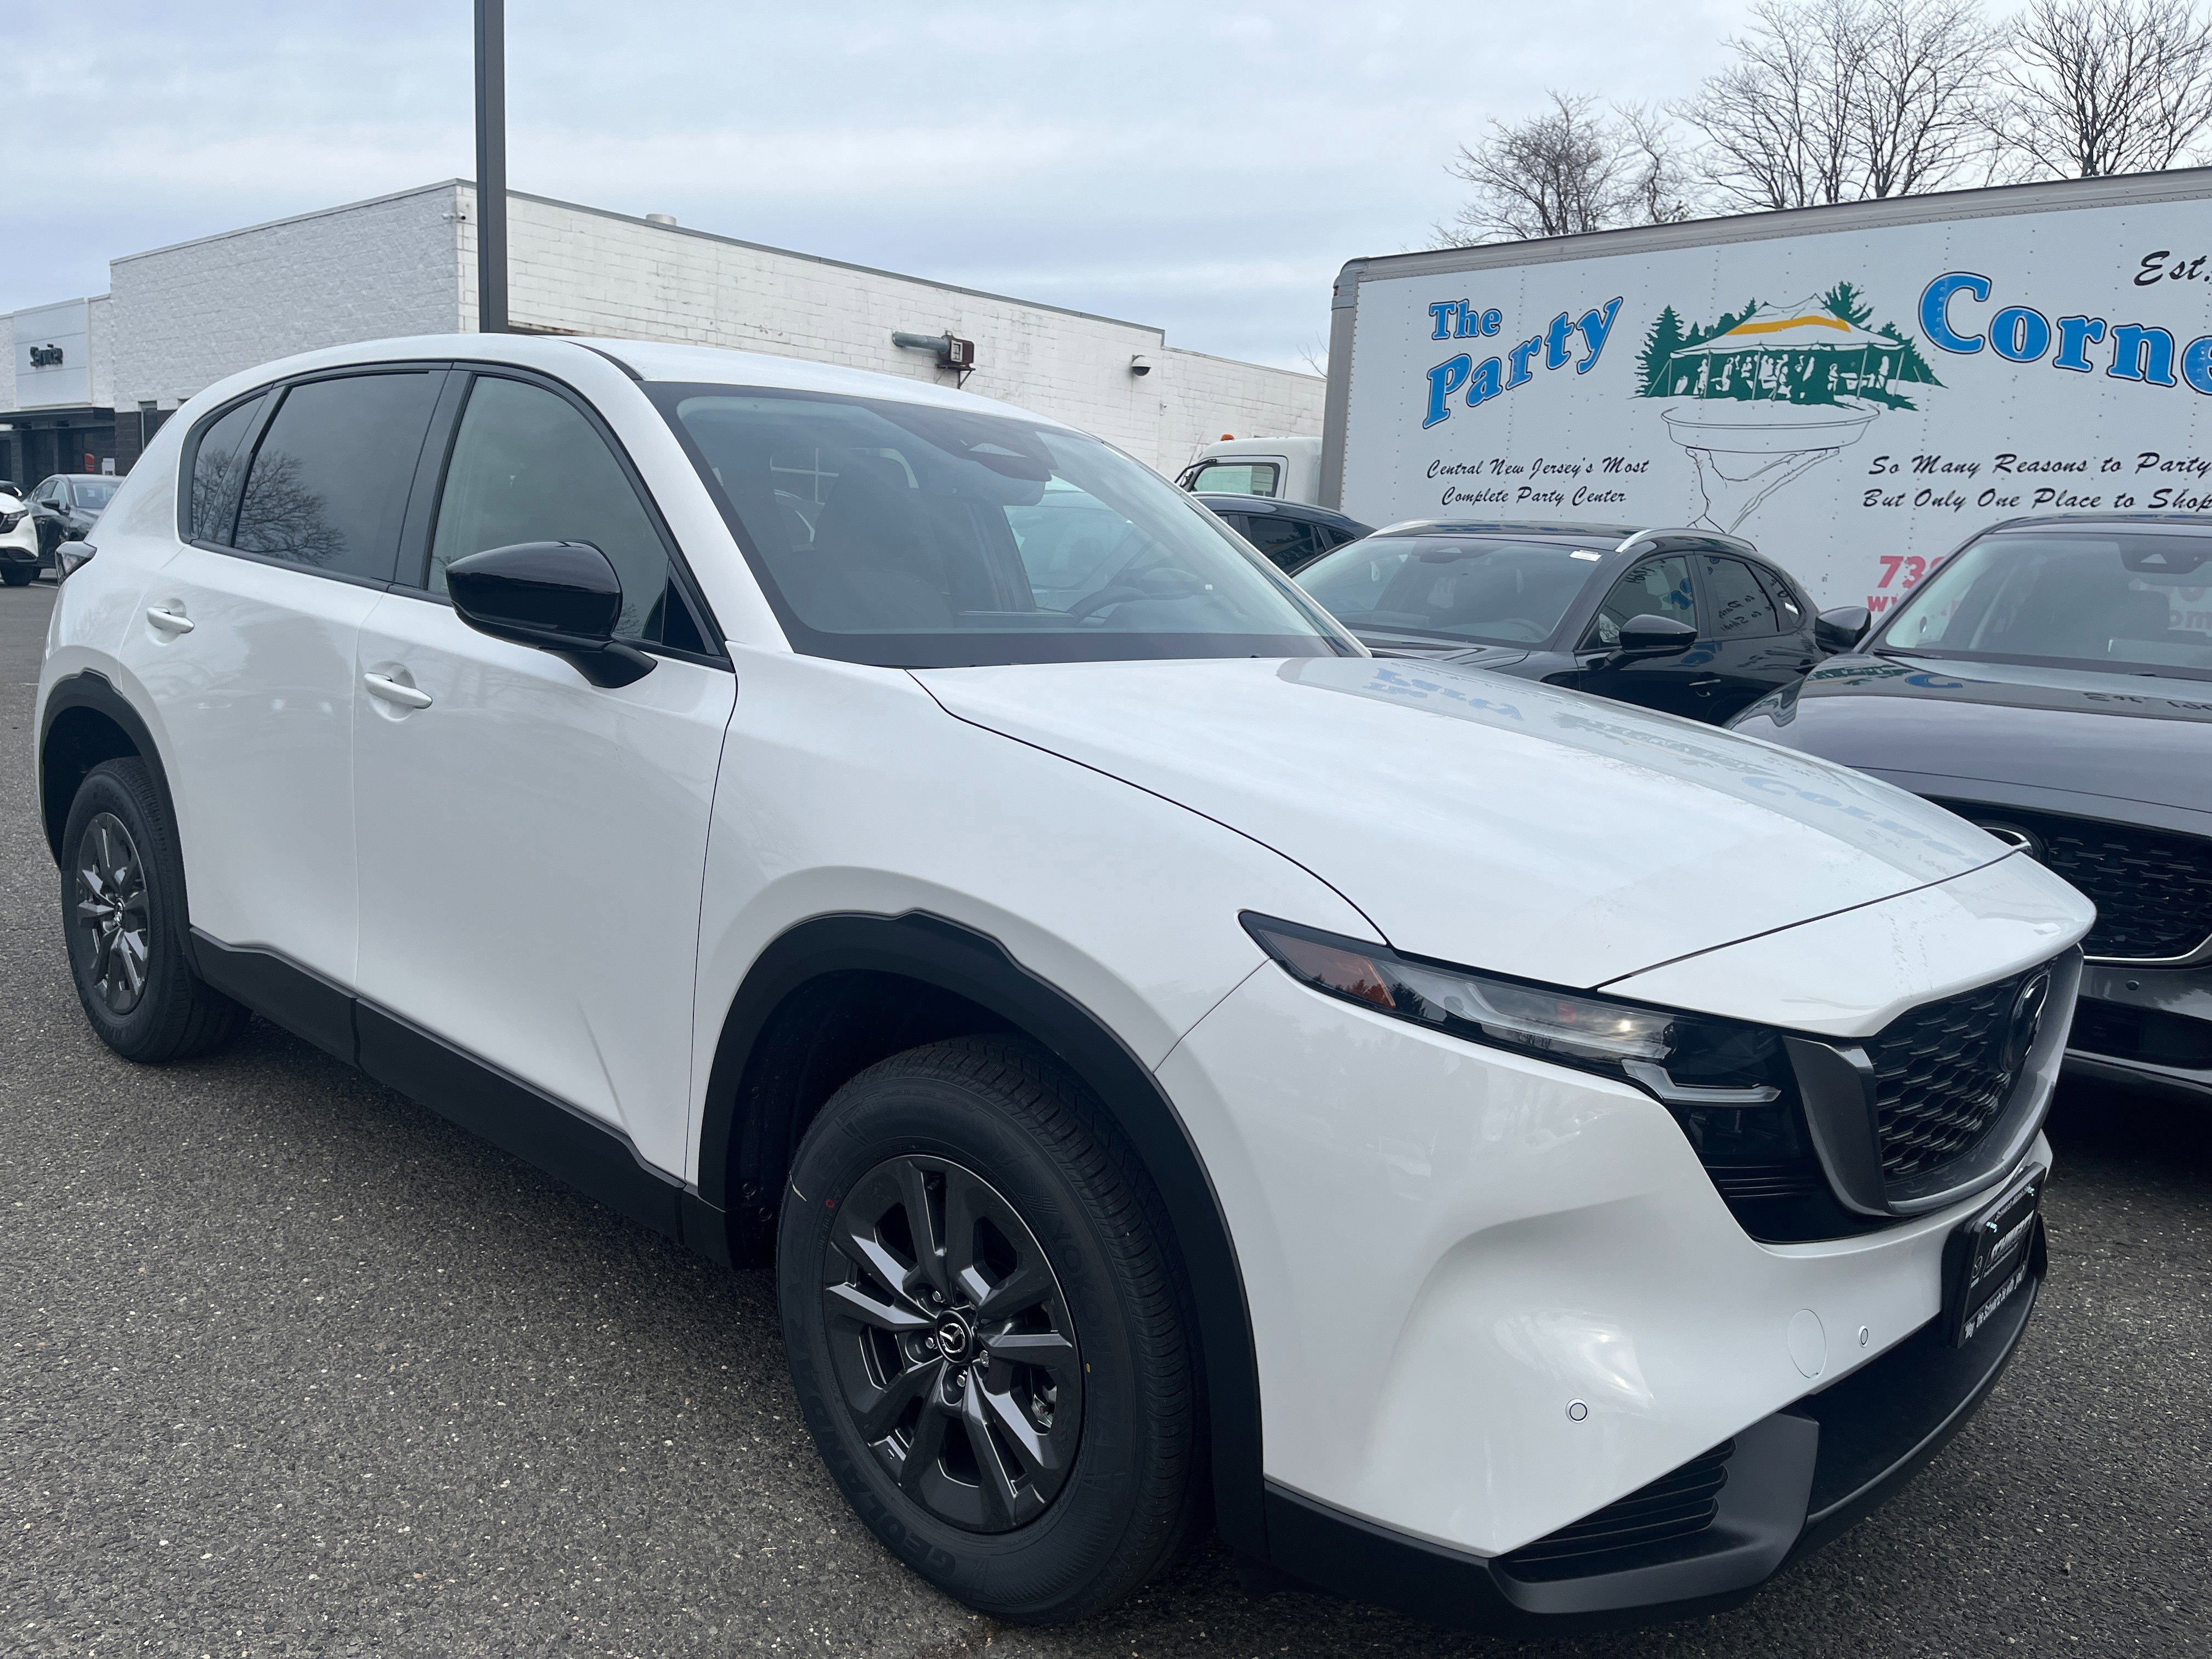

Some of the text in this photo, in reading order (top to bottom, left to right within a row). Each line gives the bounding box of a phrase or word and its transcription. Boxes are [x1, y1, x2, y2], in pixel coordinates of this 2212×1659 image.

[2133, 250, 2210, 286] Est.
[1429, 298, 1503, 340] The
[1422, 296, 1623, 430] Party
[1426, 456, 1650, 480] Central New Jersey's Most
[1867, 452, 2212, 479] So Many Reasons to Party
[1441, 486, 1627, 507] Complete Party Center
[1863, 488, 1906, 507] But
[1914, 488, 1967, 513] Only
[1977, 488, 2021, 507] One
[2031, 487, 2102, 509] Place
[2114, 493, 2136, 509] to
[1877, 555, 1945, 589] 73
